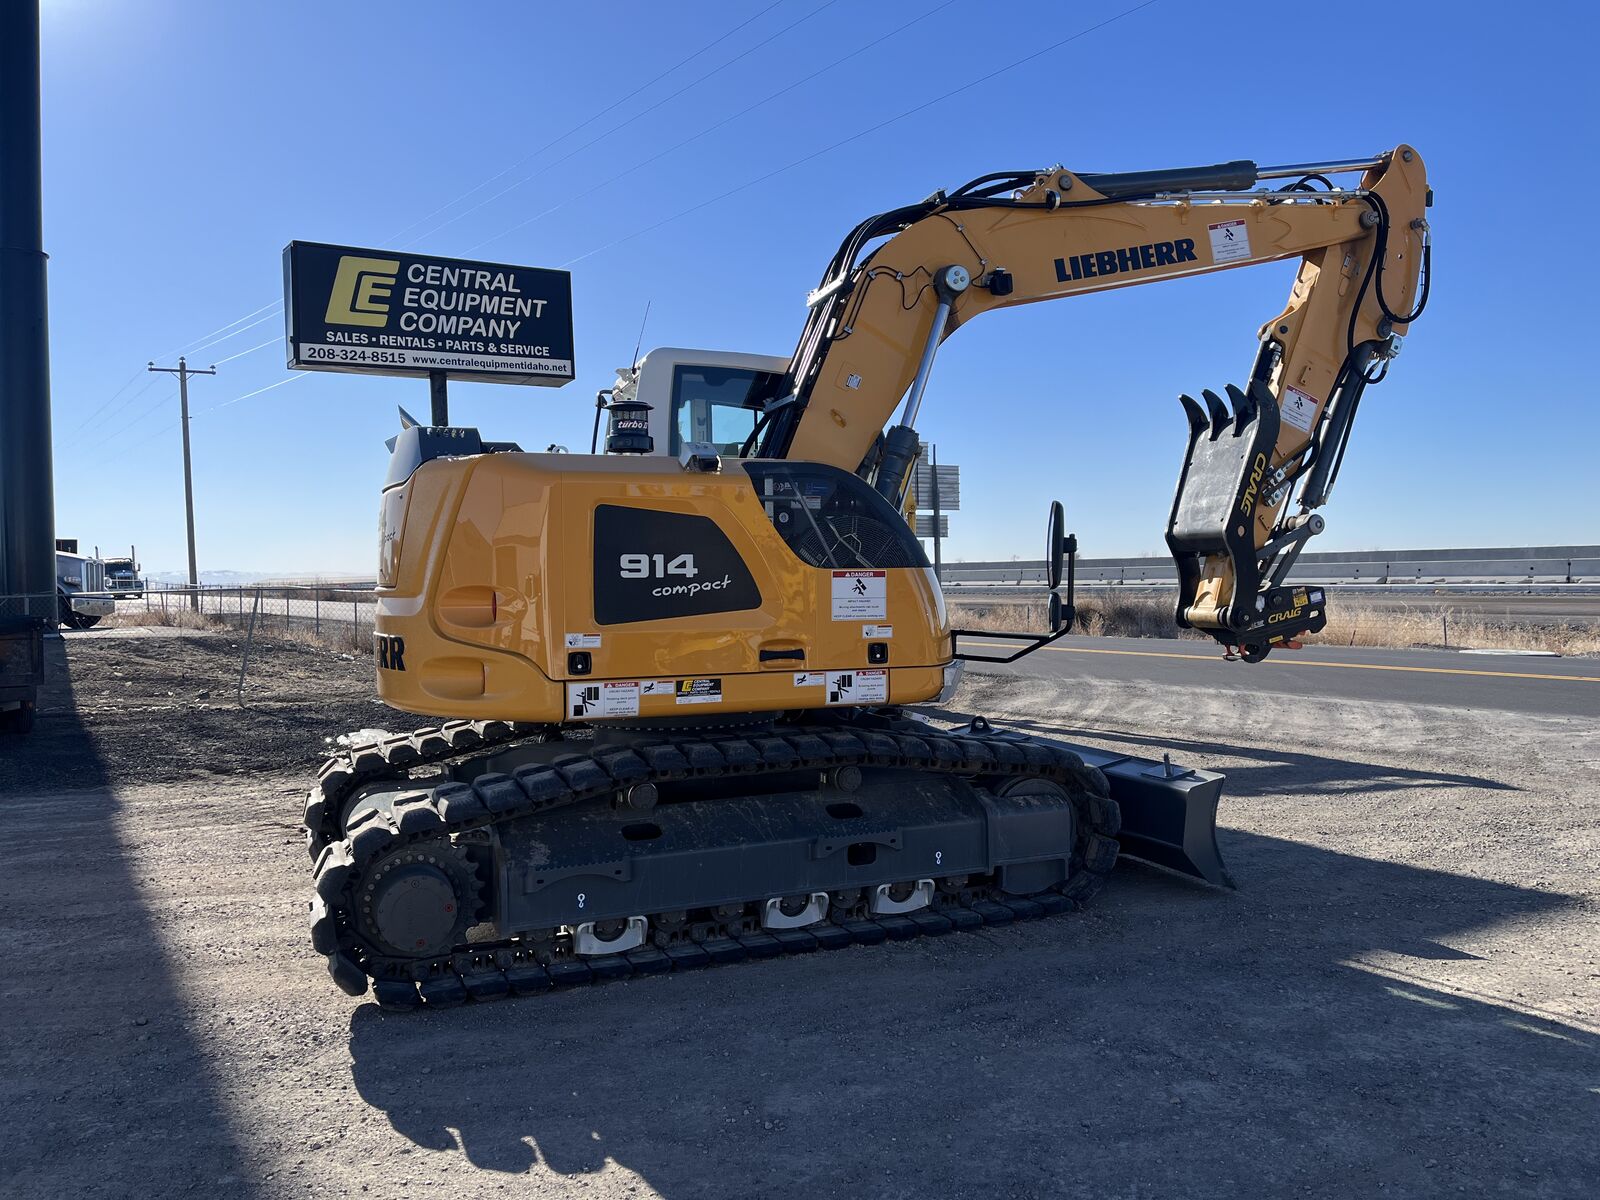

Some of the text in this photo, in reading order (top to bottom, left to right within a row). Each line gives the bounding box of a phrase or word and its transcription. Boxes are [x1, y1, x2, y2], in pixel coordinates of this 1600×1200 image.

[1054, 238, 1198, 282] LIEBHERR
[407, 263, 521, 293] CENTRAL
[403, 287, 548, 318] EQUIPMENT
[399, 311, 521, 339] COMPANY
[326, 331, 550, 356] SALES RENTALS PARTS & SERVICE
[307, 347, 567, 372] 208-324-8515 www.centralequipmentidaho.net
[618, 420, 643, 429] turbo
[1240, 452, 1267, 517] CRAIG
[620, 554, 698, 578] 914
[652, 574, 732, 597] compact
[1268, 607, 1302, 624] CRAIG
[380, 636, 406, 672] RR
